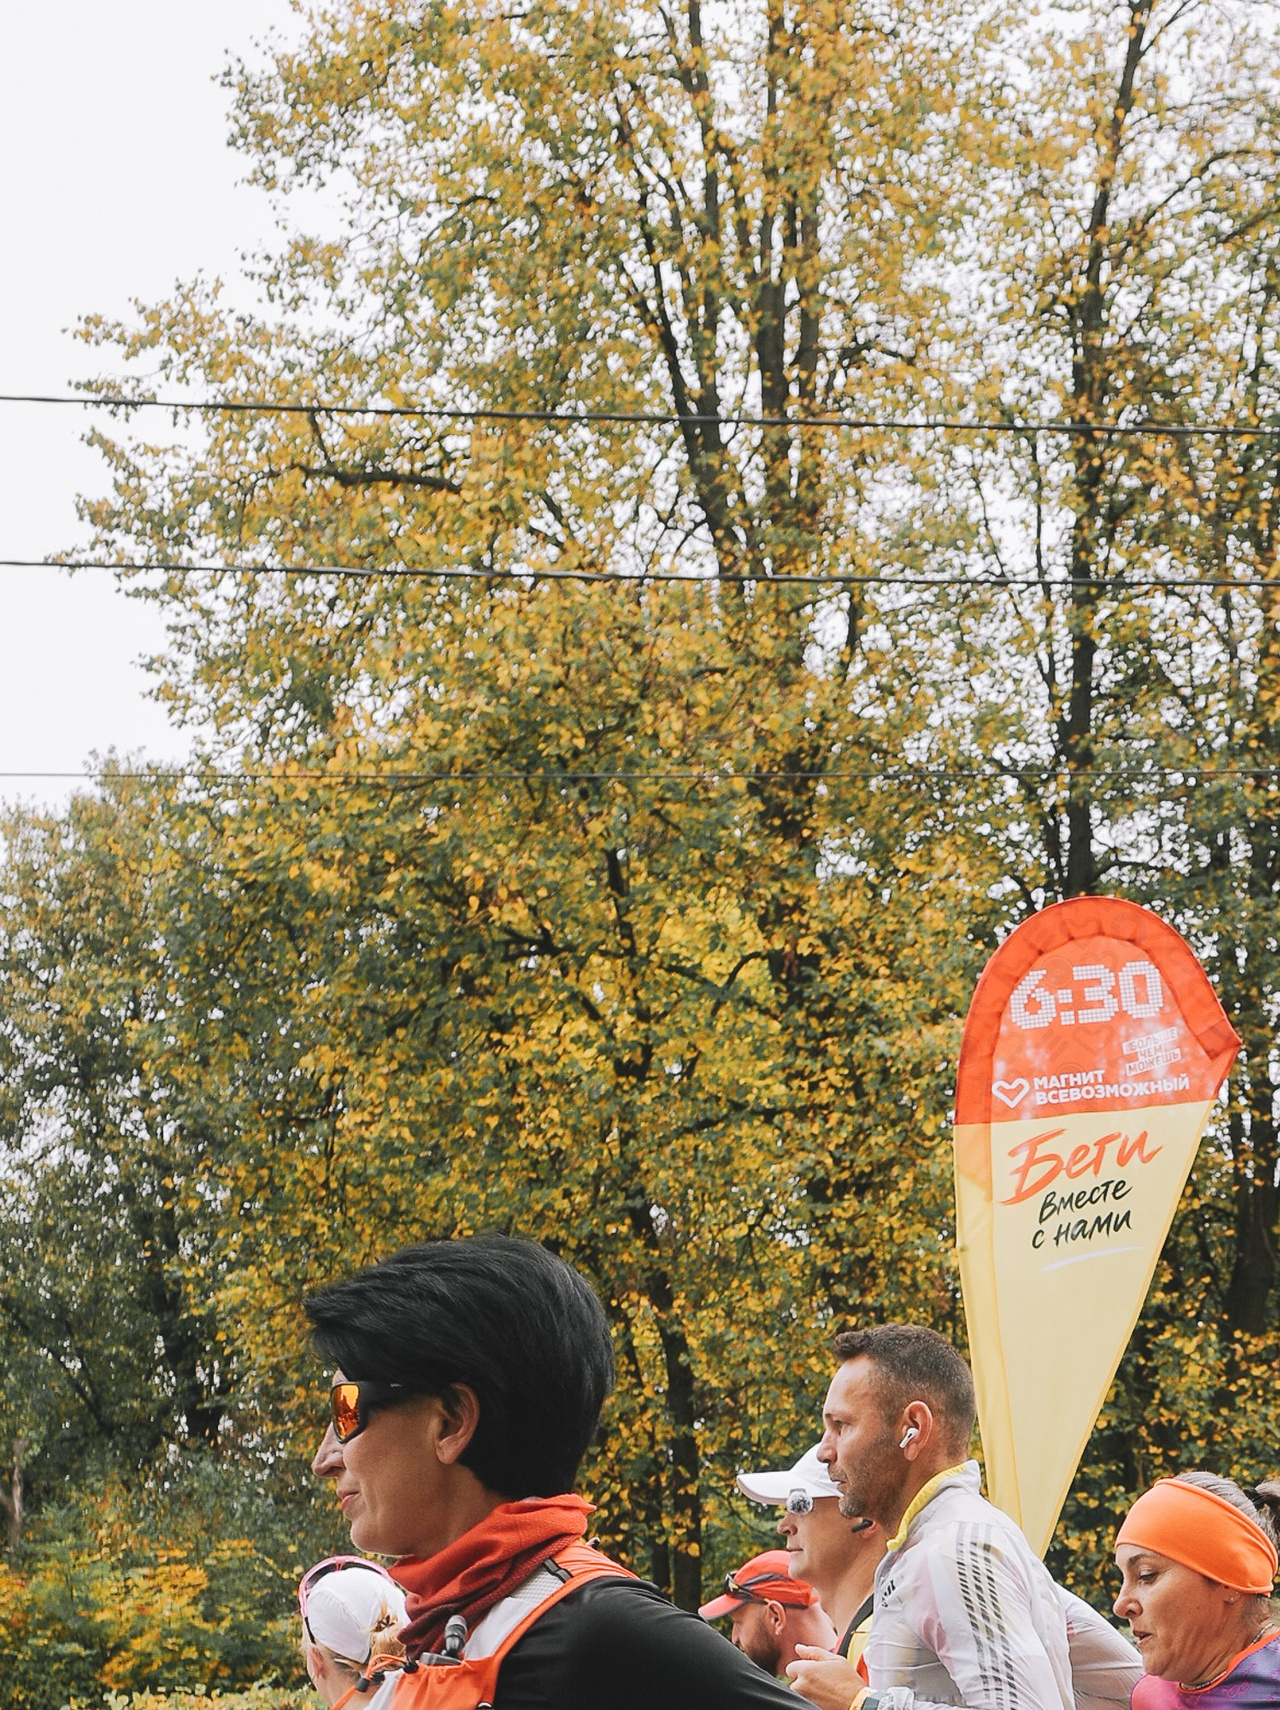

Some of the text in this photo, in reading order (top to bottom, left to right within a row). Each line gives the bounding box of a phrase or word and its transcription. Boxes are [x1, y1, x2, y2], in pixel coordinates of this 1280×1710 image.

[1010, 960, 1164, 1030] 6:30
[1129, 1028, 1178, 1051] БОЛЬШЕ
[1138, 1046, 1164, 1060] ЧЕМ
[1128, 1051, 1180, 1074] МОЖЕШЬ
[1033, 1070, 1105, 1090] МАГНИТ
[1035, 1074, 1190, 1106] ВСЕВОЗМОЖНЫЙ
[1000, 1127, 1166, 1206] Беги
[1031, 1209, 1133, 1249] с нами
